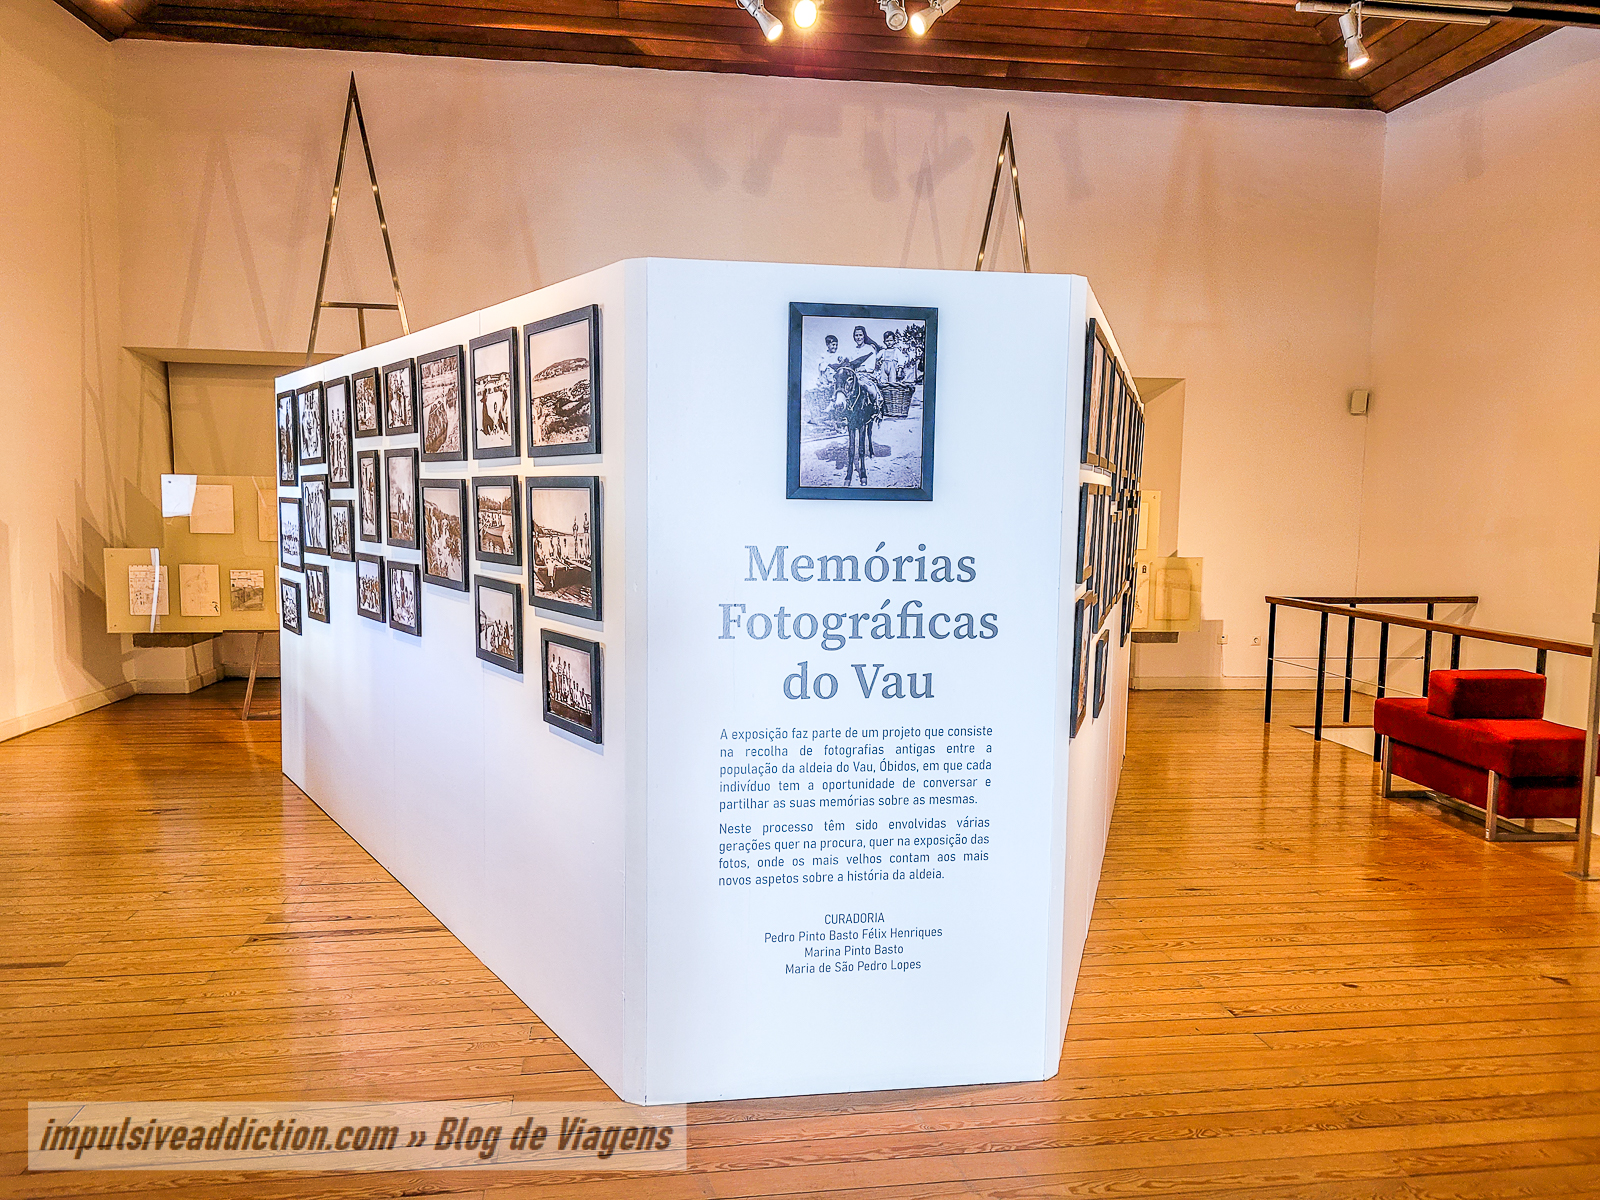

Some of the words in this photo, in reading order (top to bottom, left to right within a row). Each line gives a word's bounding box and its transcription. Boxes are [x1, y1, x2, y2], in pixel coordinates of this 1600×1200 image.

[745, 541, 976, 582] Memórias
[718, 599, 998, 651] Fotográficas
[783, 661, 838, 700] do
[851, 664, 934, 699] Vau
[720, 729, 728, 739] A
[732, 728, 788, 742] exposição
[792, 728, 808, 738] faz
[812, 728, 841, 741] parte
[845, 727, 858, 738] de
[862, 729, 878, 737] um
[883, 726, 921, 740] projeto
[925, 729, 944, 739] que
[948, 725, 992, 736] consiste
[721, 749, 733, 757] na
[746, 746, 787, 757] recolha
[800, 745, 812, 756] de
[824, 744, 885, 759] fotografias
[896, 743, 935, 757] antigas
[947, 743, 975, 753] entre
[986, 745, 992, 753] a
[720, 762, 777, 777] população
[782, 763, 794, 773] da
[799, 762, 832, 773] aldeia
[837, 762, 849, 772] do
[853, 761, 875, 773] Vau,
[880, 756, 920, 772] Óbidos,
[923, 763, 939, 771] em
[944, 762, 962, 773] que
[967, 759, 991, 770] cada
[720, 779, 770, 792] indivíduo
[779, 781, 799, 791] tem
[808, 782, 814, 790] a
[822, 778, 894, 792] oportunidade
[903, 777, 915, 788] de
[923, 779, 978, 788] conversar
[720, 798, 769, 812] partilhar
[773, 800, 785, 808] as
[790, 799, 815, 808] suas
[820, 794, 874, 807] memórias
[879, 795, 909, 805] sobre
[913, 797, 925, 805] as
[929, 796, 977, 804] mesmas.
[720, 823, 751, 834] Neste
[763, 824, 813, 836] processo
[824, 819, 844, 831] têm
[856, 819, 877, 830] sido
[889, 818, 946, 829] envolvidas
[957, 816, 990, 827] várias
[719, 839, 770, 854] gerações
[775, 841, 800, 852] quer
[804, 841, 816, 849] na
[820, 839, 865, 851] procura,
[869, 838, 894, 849] quer
[898, 838, 910, 846] na
[914, 834, 967, 848] exposição
[971, 834, 989, 844] das
[719, 858, 749, 869] fotos,
[758, 856, 784, 867] onde
[793, 858, 804, 866] os
[813, 854, 838, 865] mais
[846, 853, 882, 864] velhos
[890, 853, 929, 863] contam
[937, 854, 955, 862] aos
[964, 850, 988, 861] mais
[719, 877, 751, 886] novos
[756, 874, 798, 887] aspetos
[803, 872, 833, 883] sobre
[848, 869, 888, 881] história
[893, 869, 905, 880] da
[909, 868, 944, 879] aldeia.
[825, 912, 885, 924] CURADORIA
[765, 932, 794, 943] Pedro
[799, 931, 825, 941] Pinto
[830, 930, 858, 940] Basto
[862, 927, 886, 939] Félix
[891, 927, 942, 939] Henriques
[805, 946, 840, 957] Marina
[845, 945, 870, 956] Pinto
[875, 944, 903, 954] Basto
[786, 963, 815, 974] Maria
[819, 963, 831, 973] de
[835, 961, 853, 972] São
[858, 961, 887, 971] Pedro
[891, 960, 921, 972] Lopes
